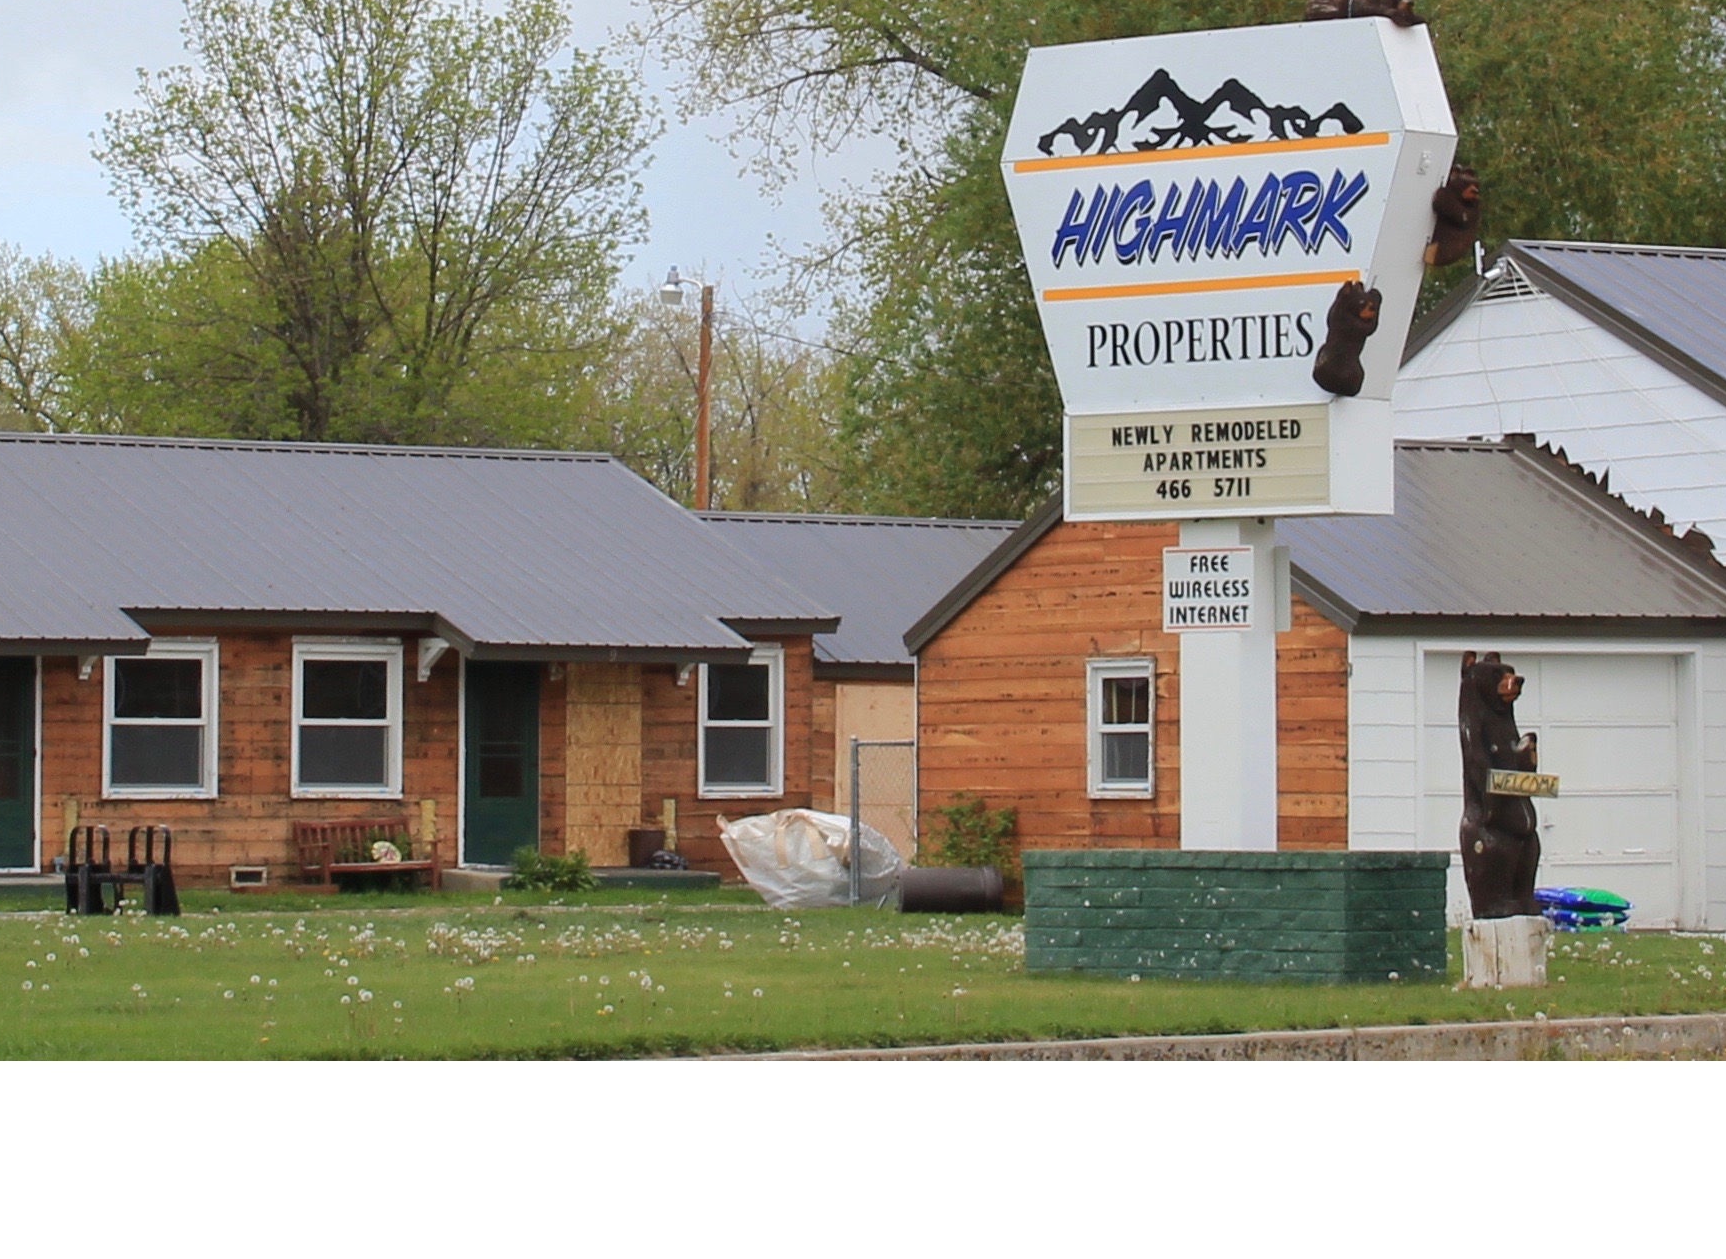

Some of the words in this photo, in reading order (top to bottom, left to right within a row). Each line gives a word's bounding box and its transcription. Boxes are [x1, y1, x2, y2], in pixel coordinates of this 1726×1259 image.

[1051, 167, 1370, 271] HIGHMARK
[1086, 311, 1314, 369] PROPERTIES
[1111, 424, 1174, 447] NEWLY
[1191, 419, 1301, 443] REMODELED
[1143, 448, 1267, 472] APARTMENTS
[1156, 479, 1192, 500] 466
[1213, 477, 1251, 498] 5711
[1190, 554, 1229, 573] FREE
[1169, 579, 1250, 599] WIRELESS
[1169, 605, 1249, 624] INTERNET
[1491, 771, 1559, 797] WELCOME
